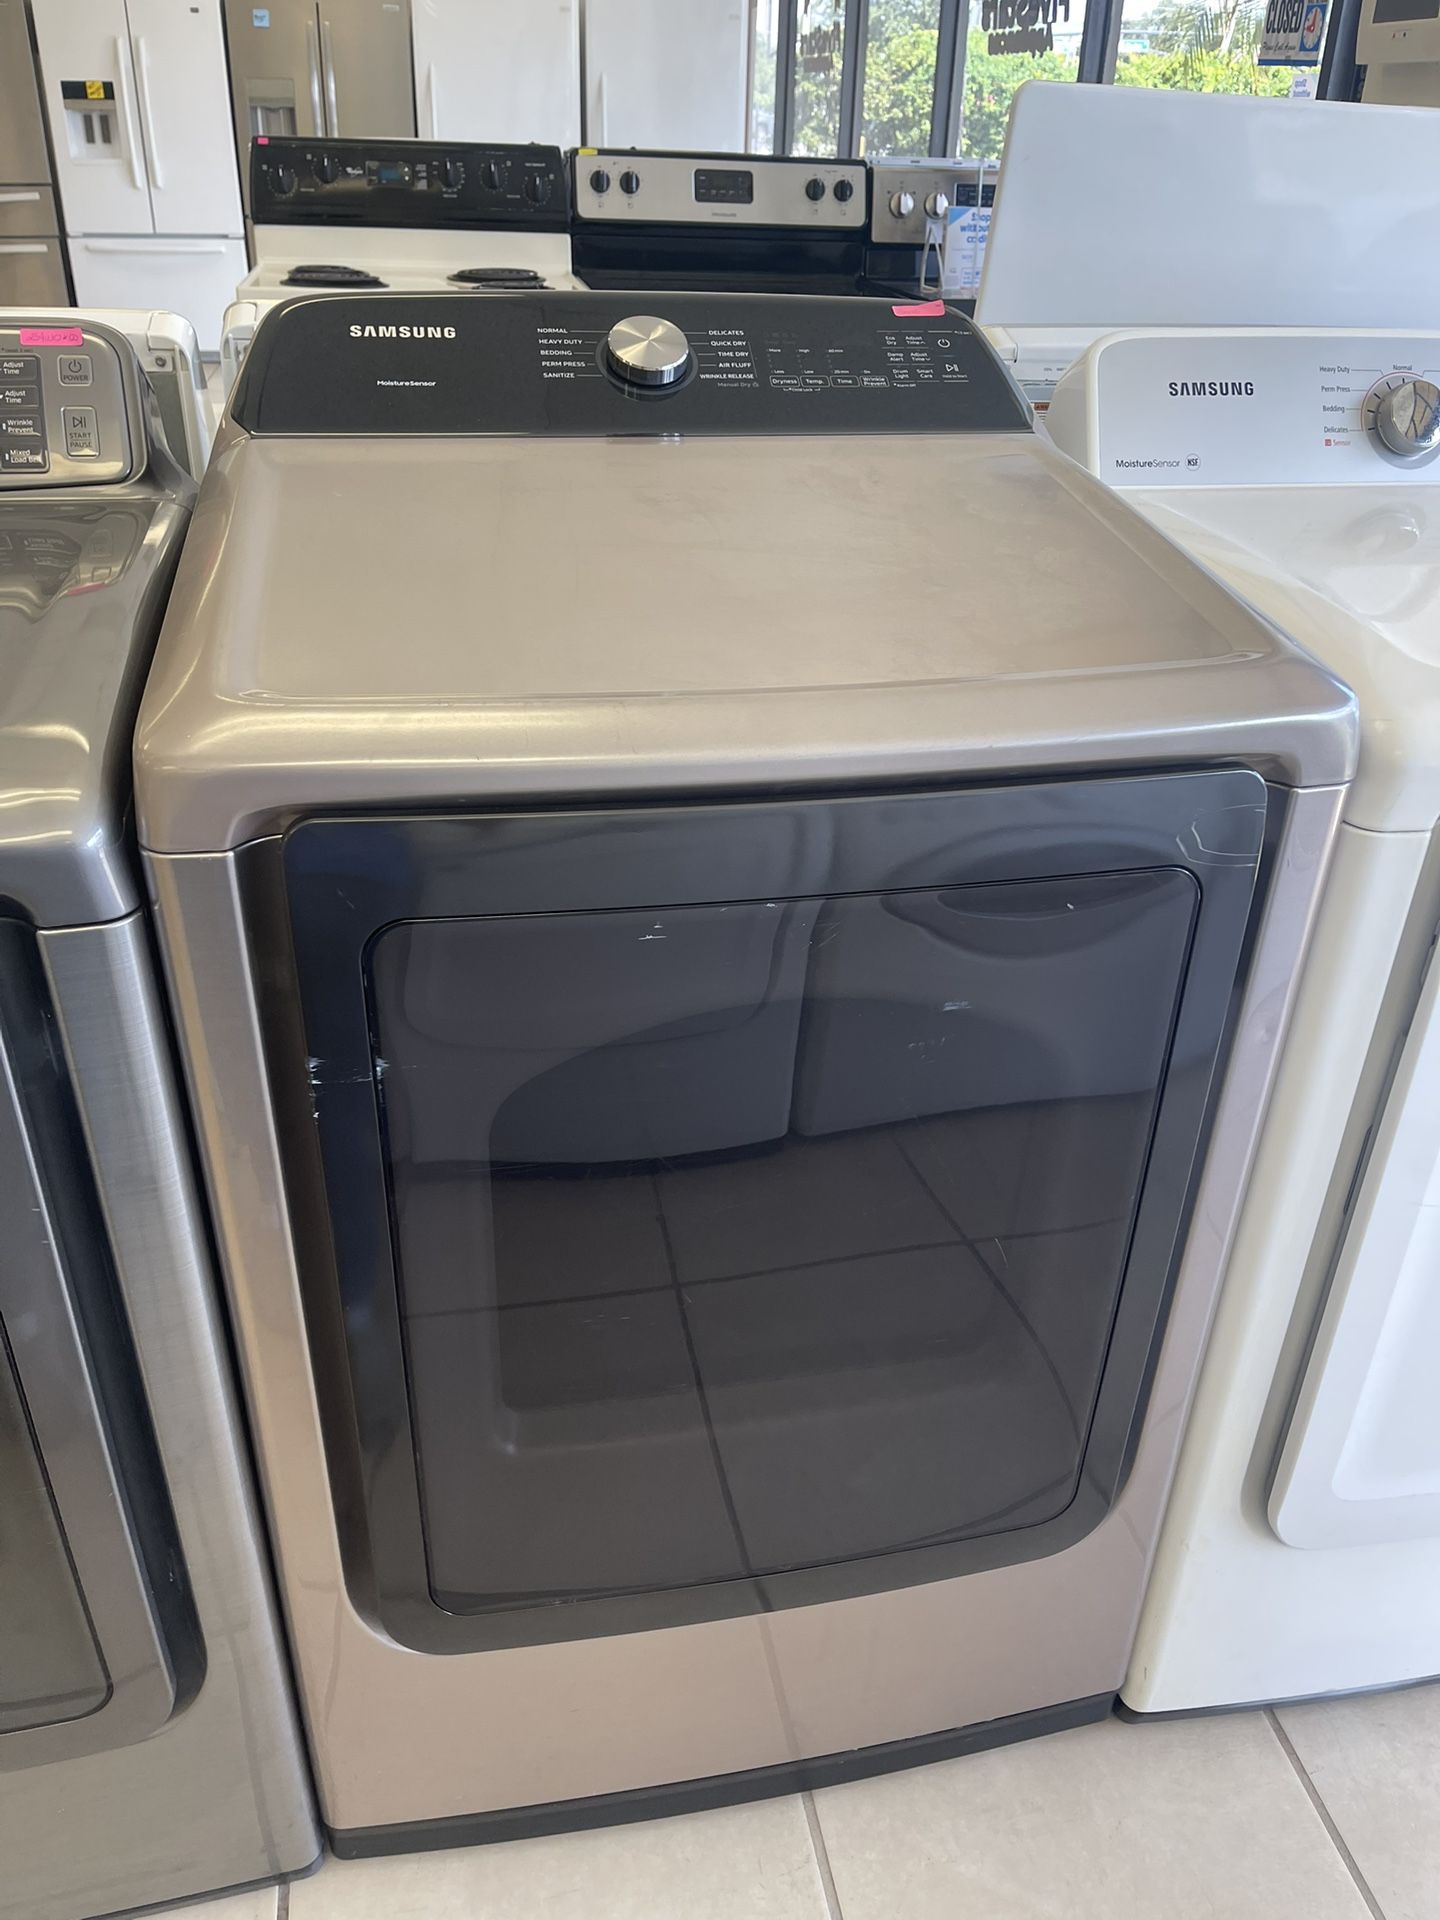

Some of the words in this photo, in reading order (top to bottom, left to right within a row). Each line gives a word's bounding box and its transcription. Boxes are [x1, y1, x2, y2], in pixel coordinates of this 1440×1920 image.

[1266, 0, 1305, 34] CLOSED
[349, 325, 456, 339] SAMSUNG
[3, 361, 24, 369] Adjust
[1319, 365, 1336, 374] Heavy
[1337, 365, 1350, 374] Duty
[5, 390, 26, 398] Adjust
[1168, 382, 1254, 397] SAMSUNG
[1322, 404, 1345, 413] Bedding
[1323, 425, 1349, 433] Delicates
[1115, 459, 1180, 468] MoistureSensor
[1187, 458, 1198, 466] NSF
